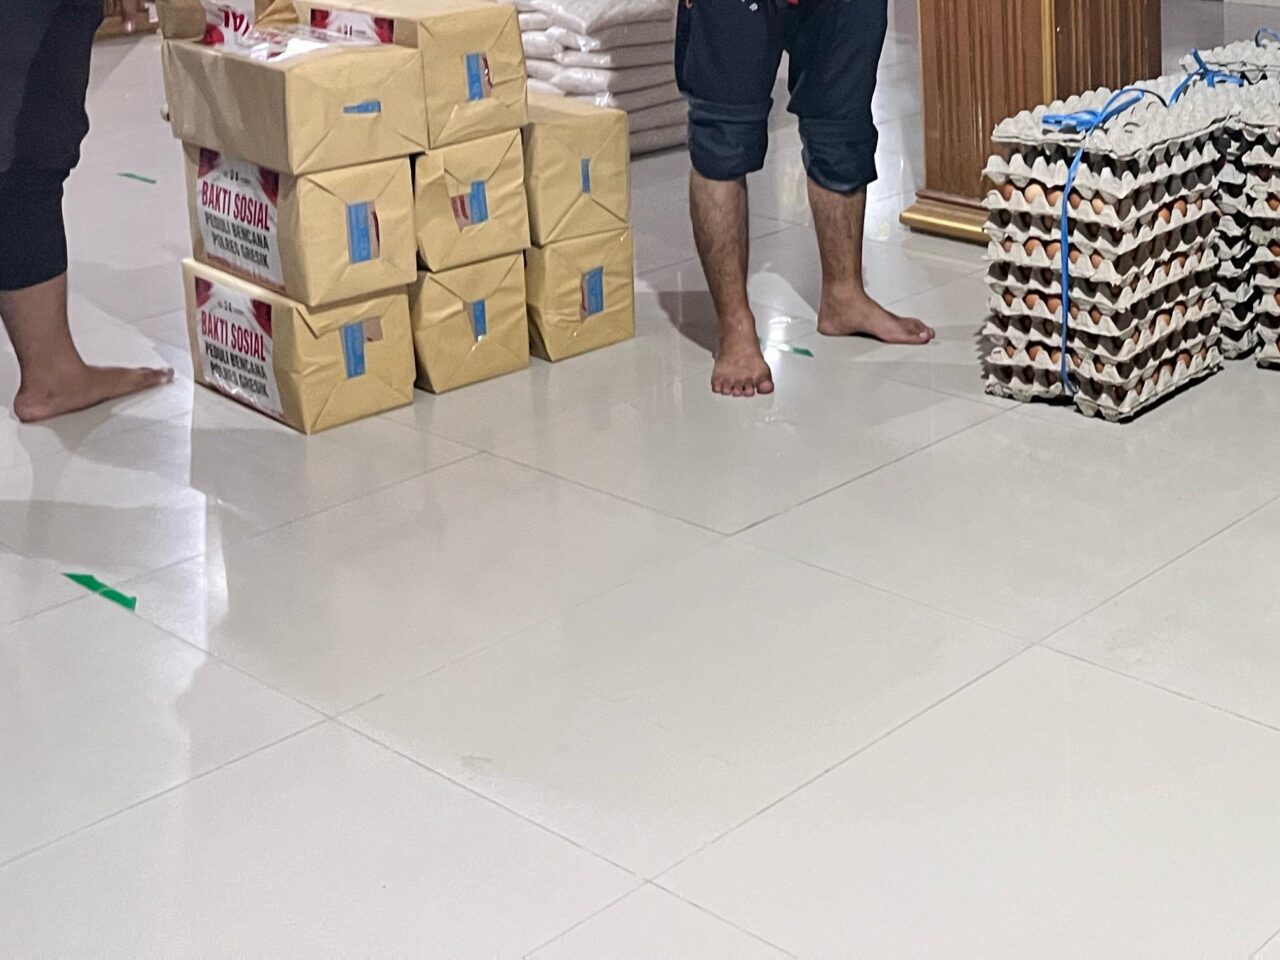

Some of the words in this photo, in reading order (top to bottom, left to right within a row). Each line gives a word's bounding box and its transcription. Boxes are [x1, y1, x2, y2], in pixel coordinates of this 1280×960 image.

[202, 180, 231, 216] BAKTI
[233, 193, 270, 232] SOSIAL
[201, 310, 229, 346] BAKTI
[230, 323, 266, 362] SOSIAL
